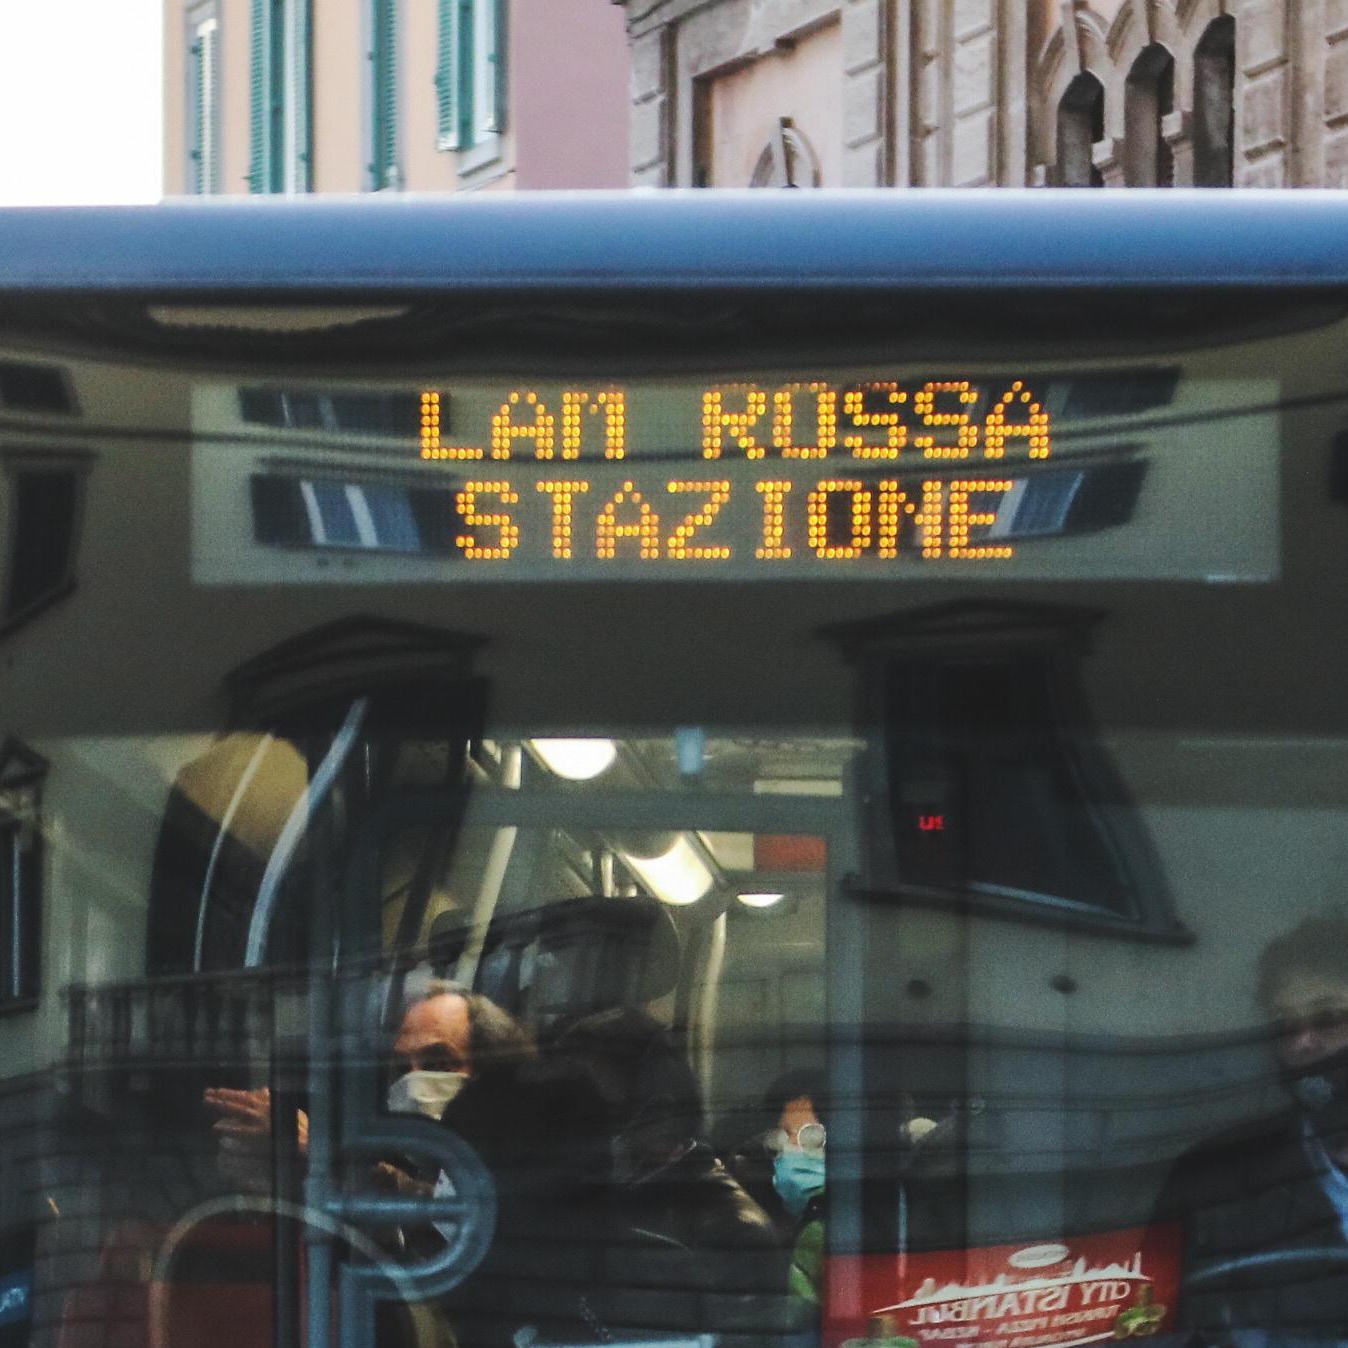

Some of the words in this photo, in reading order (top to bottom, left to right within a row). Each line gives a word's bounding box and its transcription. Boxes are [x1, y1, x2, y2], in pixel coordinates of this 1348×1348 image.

[420, 385, 624, 460] LAM
[702, 382, 1049, 460] ROSSA
[455, 481, 1012, 559] STAZIONE
